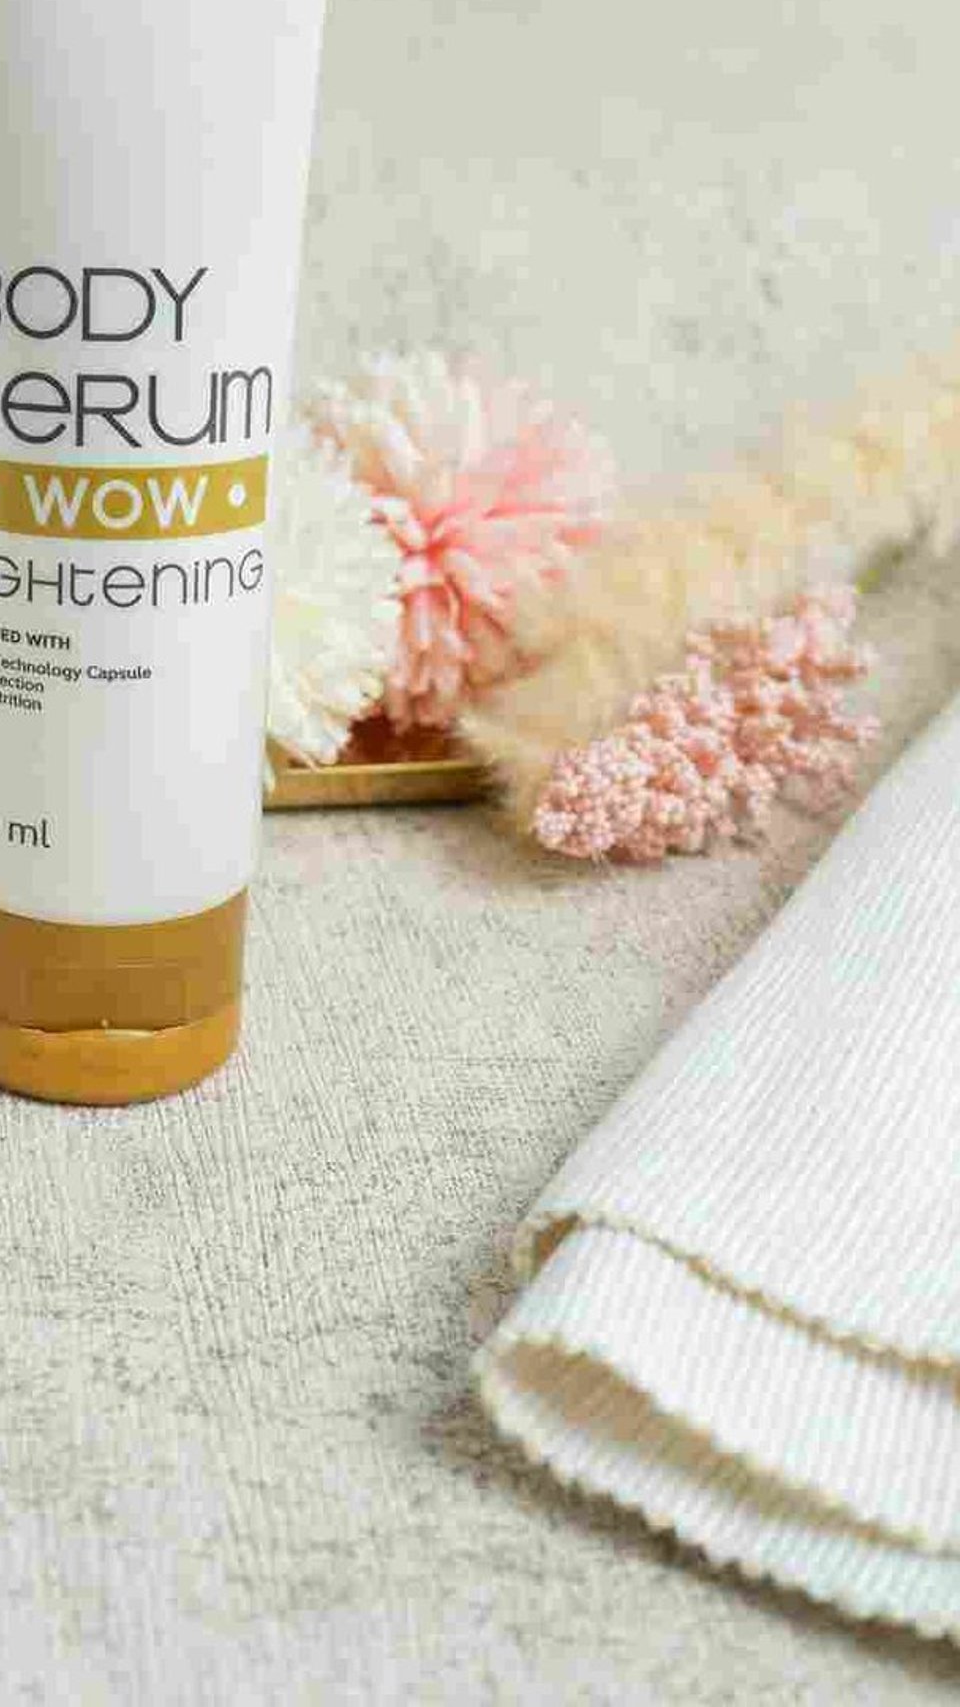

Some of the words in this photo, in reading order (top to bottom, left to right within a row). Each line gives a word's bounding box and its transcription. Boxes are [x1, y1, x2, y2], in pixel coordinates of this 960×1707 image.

[24, 475, 209, 530] WOW
[25, 632, 71, 650] WITH
[86, 665, 152, 683] Capsule
[8, 819, 51, 848] ml
